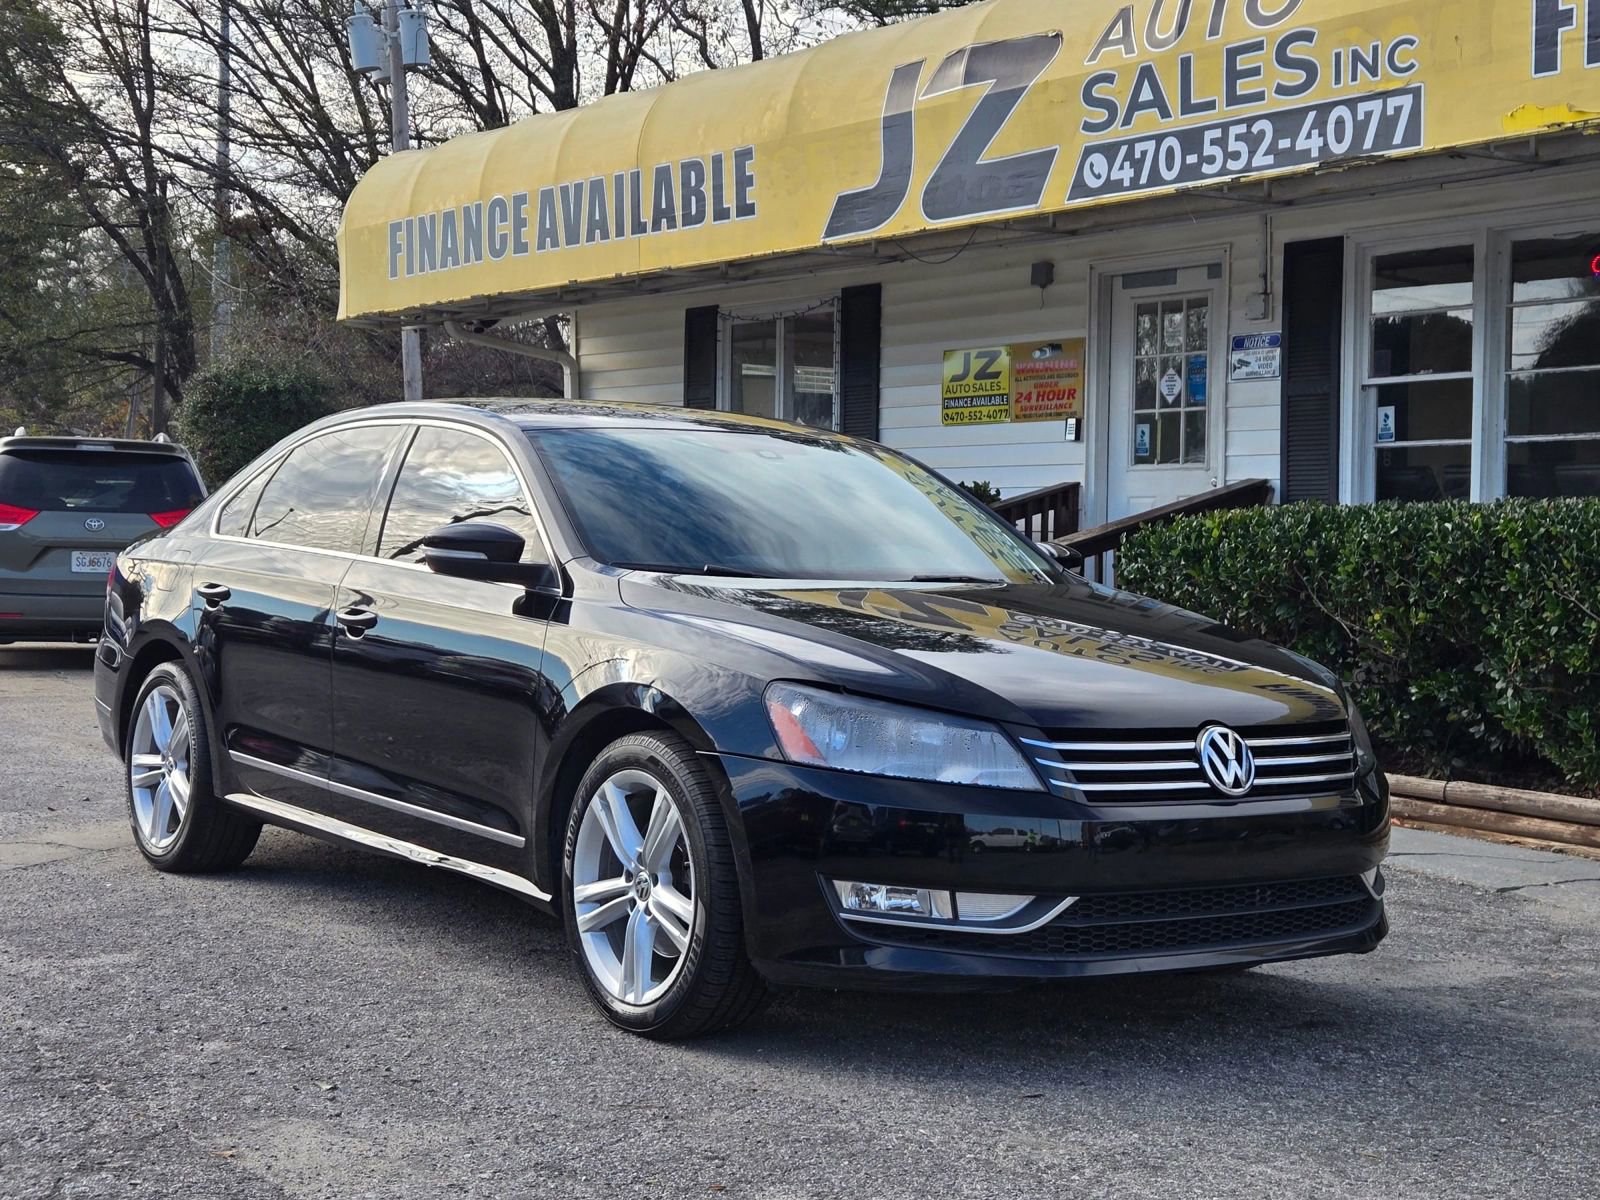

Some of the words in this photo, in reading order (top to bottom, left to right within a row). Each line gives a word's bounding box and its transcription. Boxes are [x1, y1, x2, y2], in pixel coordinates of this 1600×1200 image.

[1081, 28, 1320, 135] SALES
[1332, 36, 1419, 88] INC
[821, 29, 1063, 242] JZ
[1110, 94, 1413, 188] 470-552-4077
[388, 192, 529, 280] FINANCE
[535, 145, 757, 254] AVAILABLE
[1244, 336, 1270, 348] NOTICE
[949, 350, 1002, 383] JZ
[945, 383, 970, 395] AUTO
[972, 381, 1001, 392] SALES
[1015, 391, 1032, 403] 24
[1036, 388, 1076, 402] HOUR
[944, 397, 972, 408] FINANCE
[972, 395, 1008, 406] AVAILABLE
[1020, 402, 1073, 412] SURVEILLANCE
[950, 409, 1009, 422] 470-552-4077
